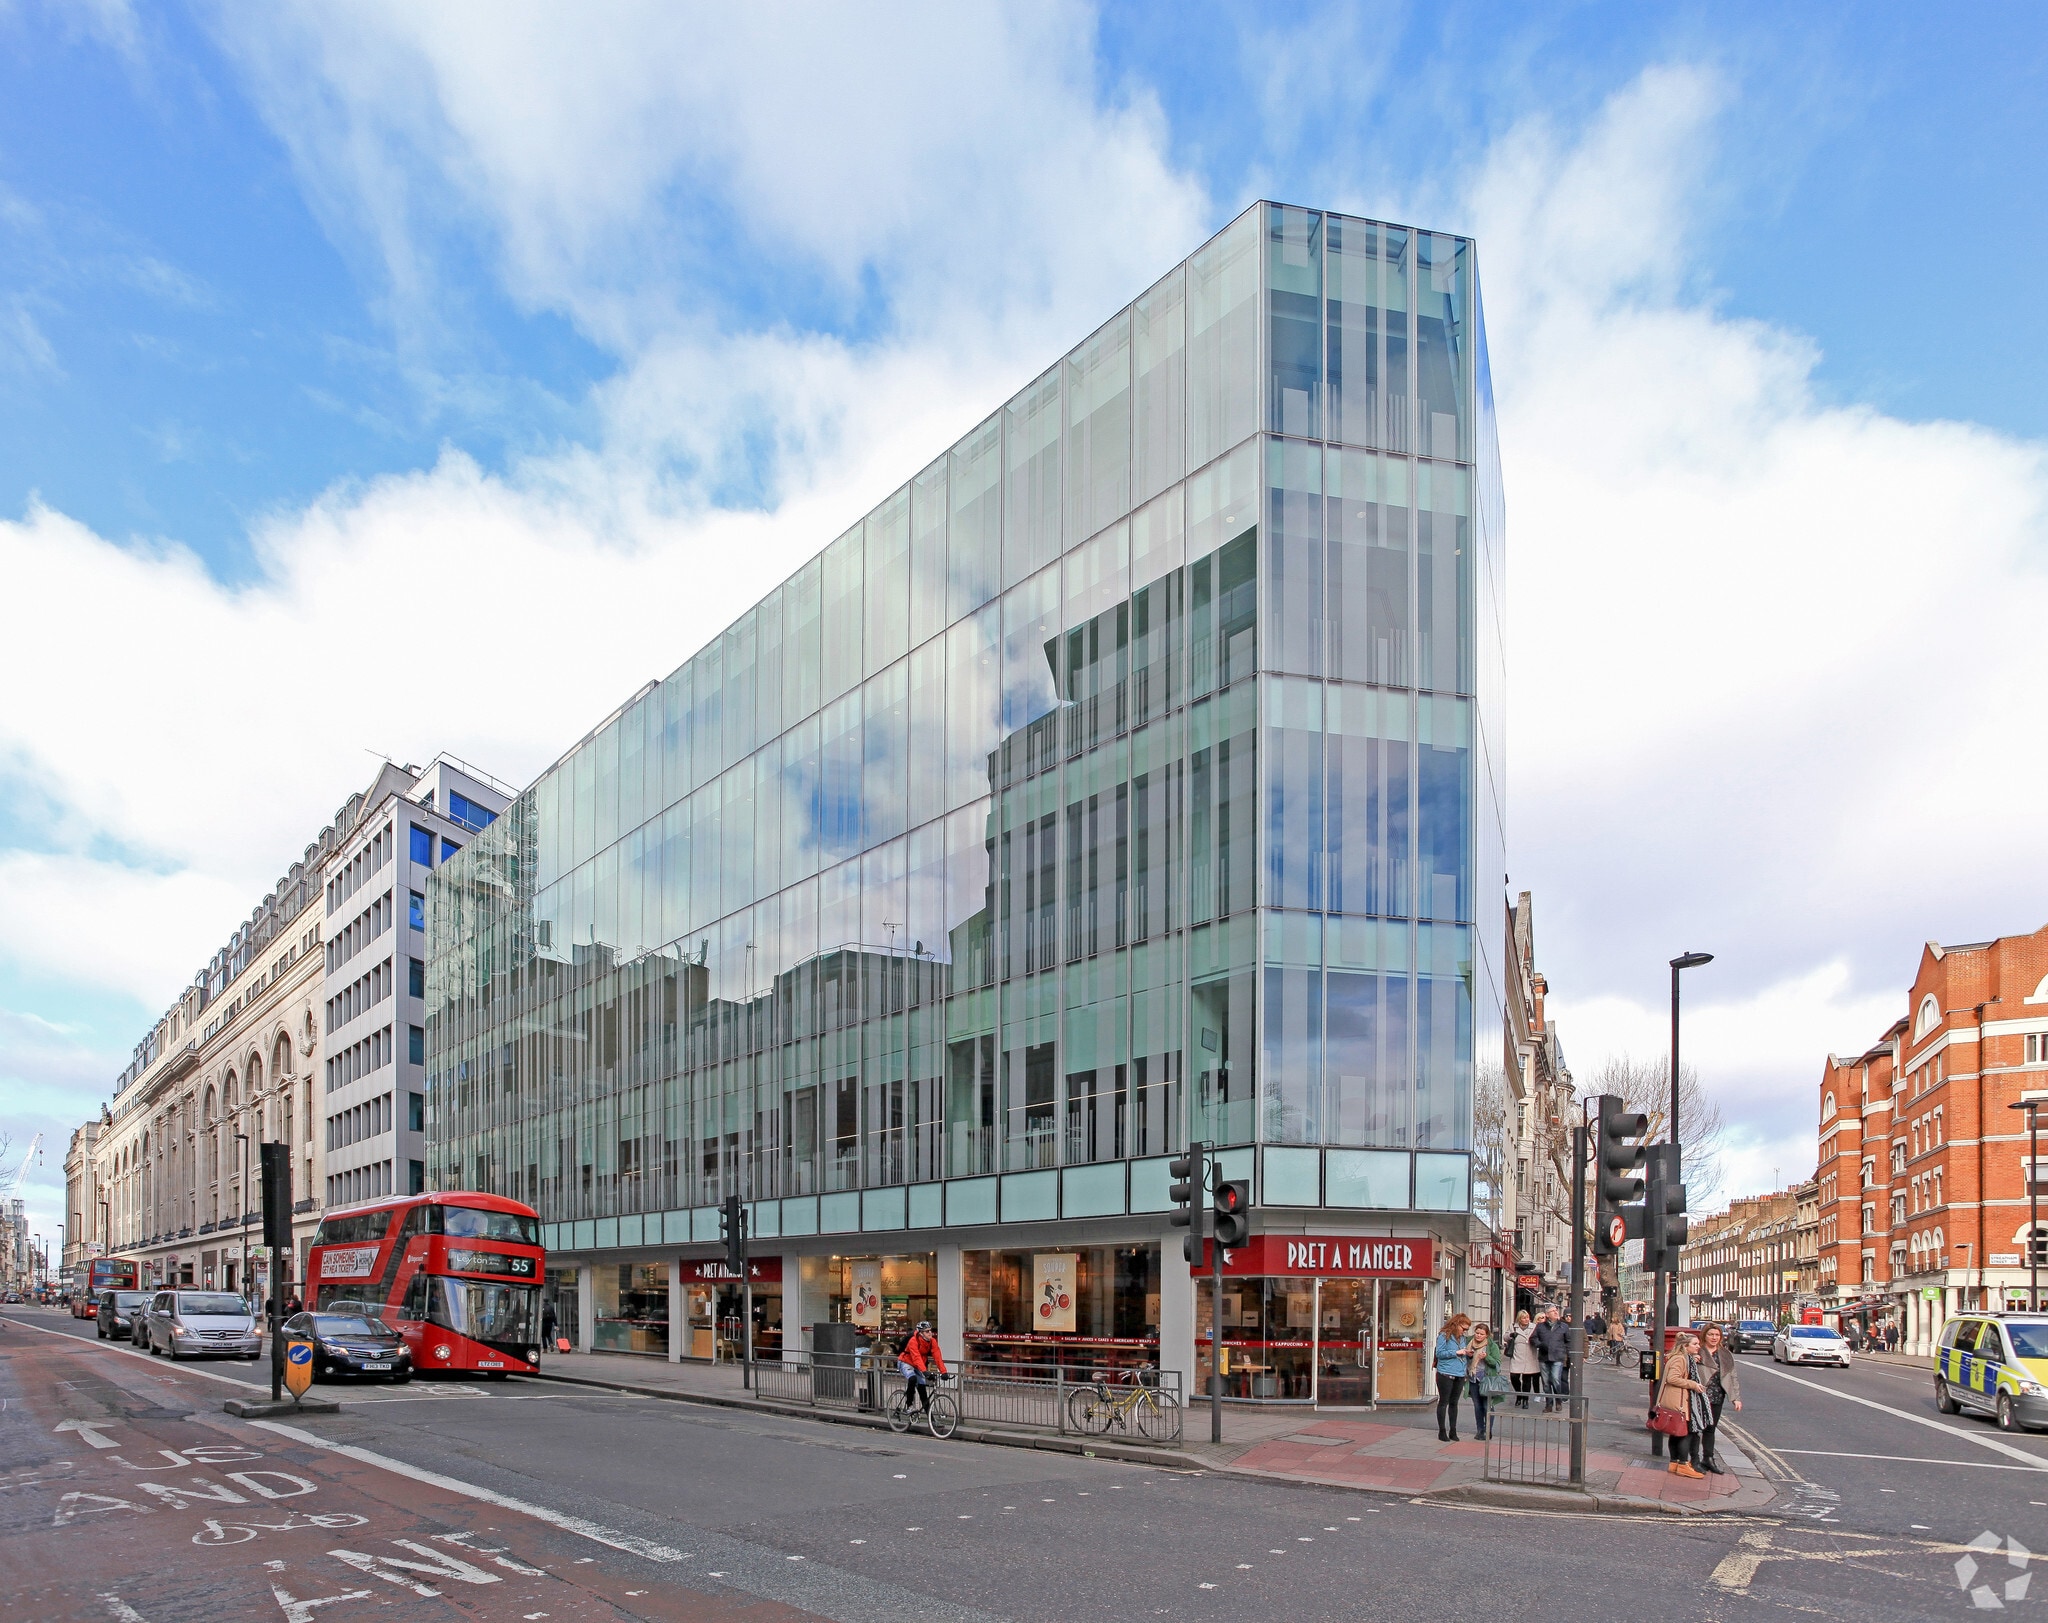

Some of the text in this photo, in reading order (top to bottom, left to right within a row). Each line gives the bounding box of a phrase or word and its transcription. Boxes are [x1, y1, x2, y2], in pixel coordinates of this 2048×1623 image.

[323, 1253, 332, 1264] CAN
[333, 1251, 356, 1264] SOMEONE
[456, 1253, 488, 1265] Leyton
[511, 1260, 529, 1272] 55
[1287, 1241, 1412, 1270] PRET A MANGER
[703, 1263, 717, 1278] PRET
[718, 1263, 722, 1278] A
[52, 1471, 318, 1526] AND
